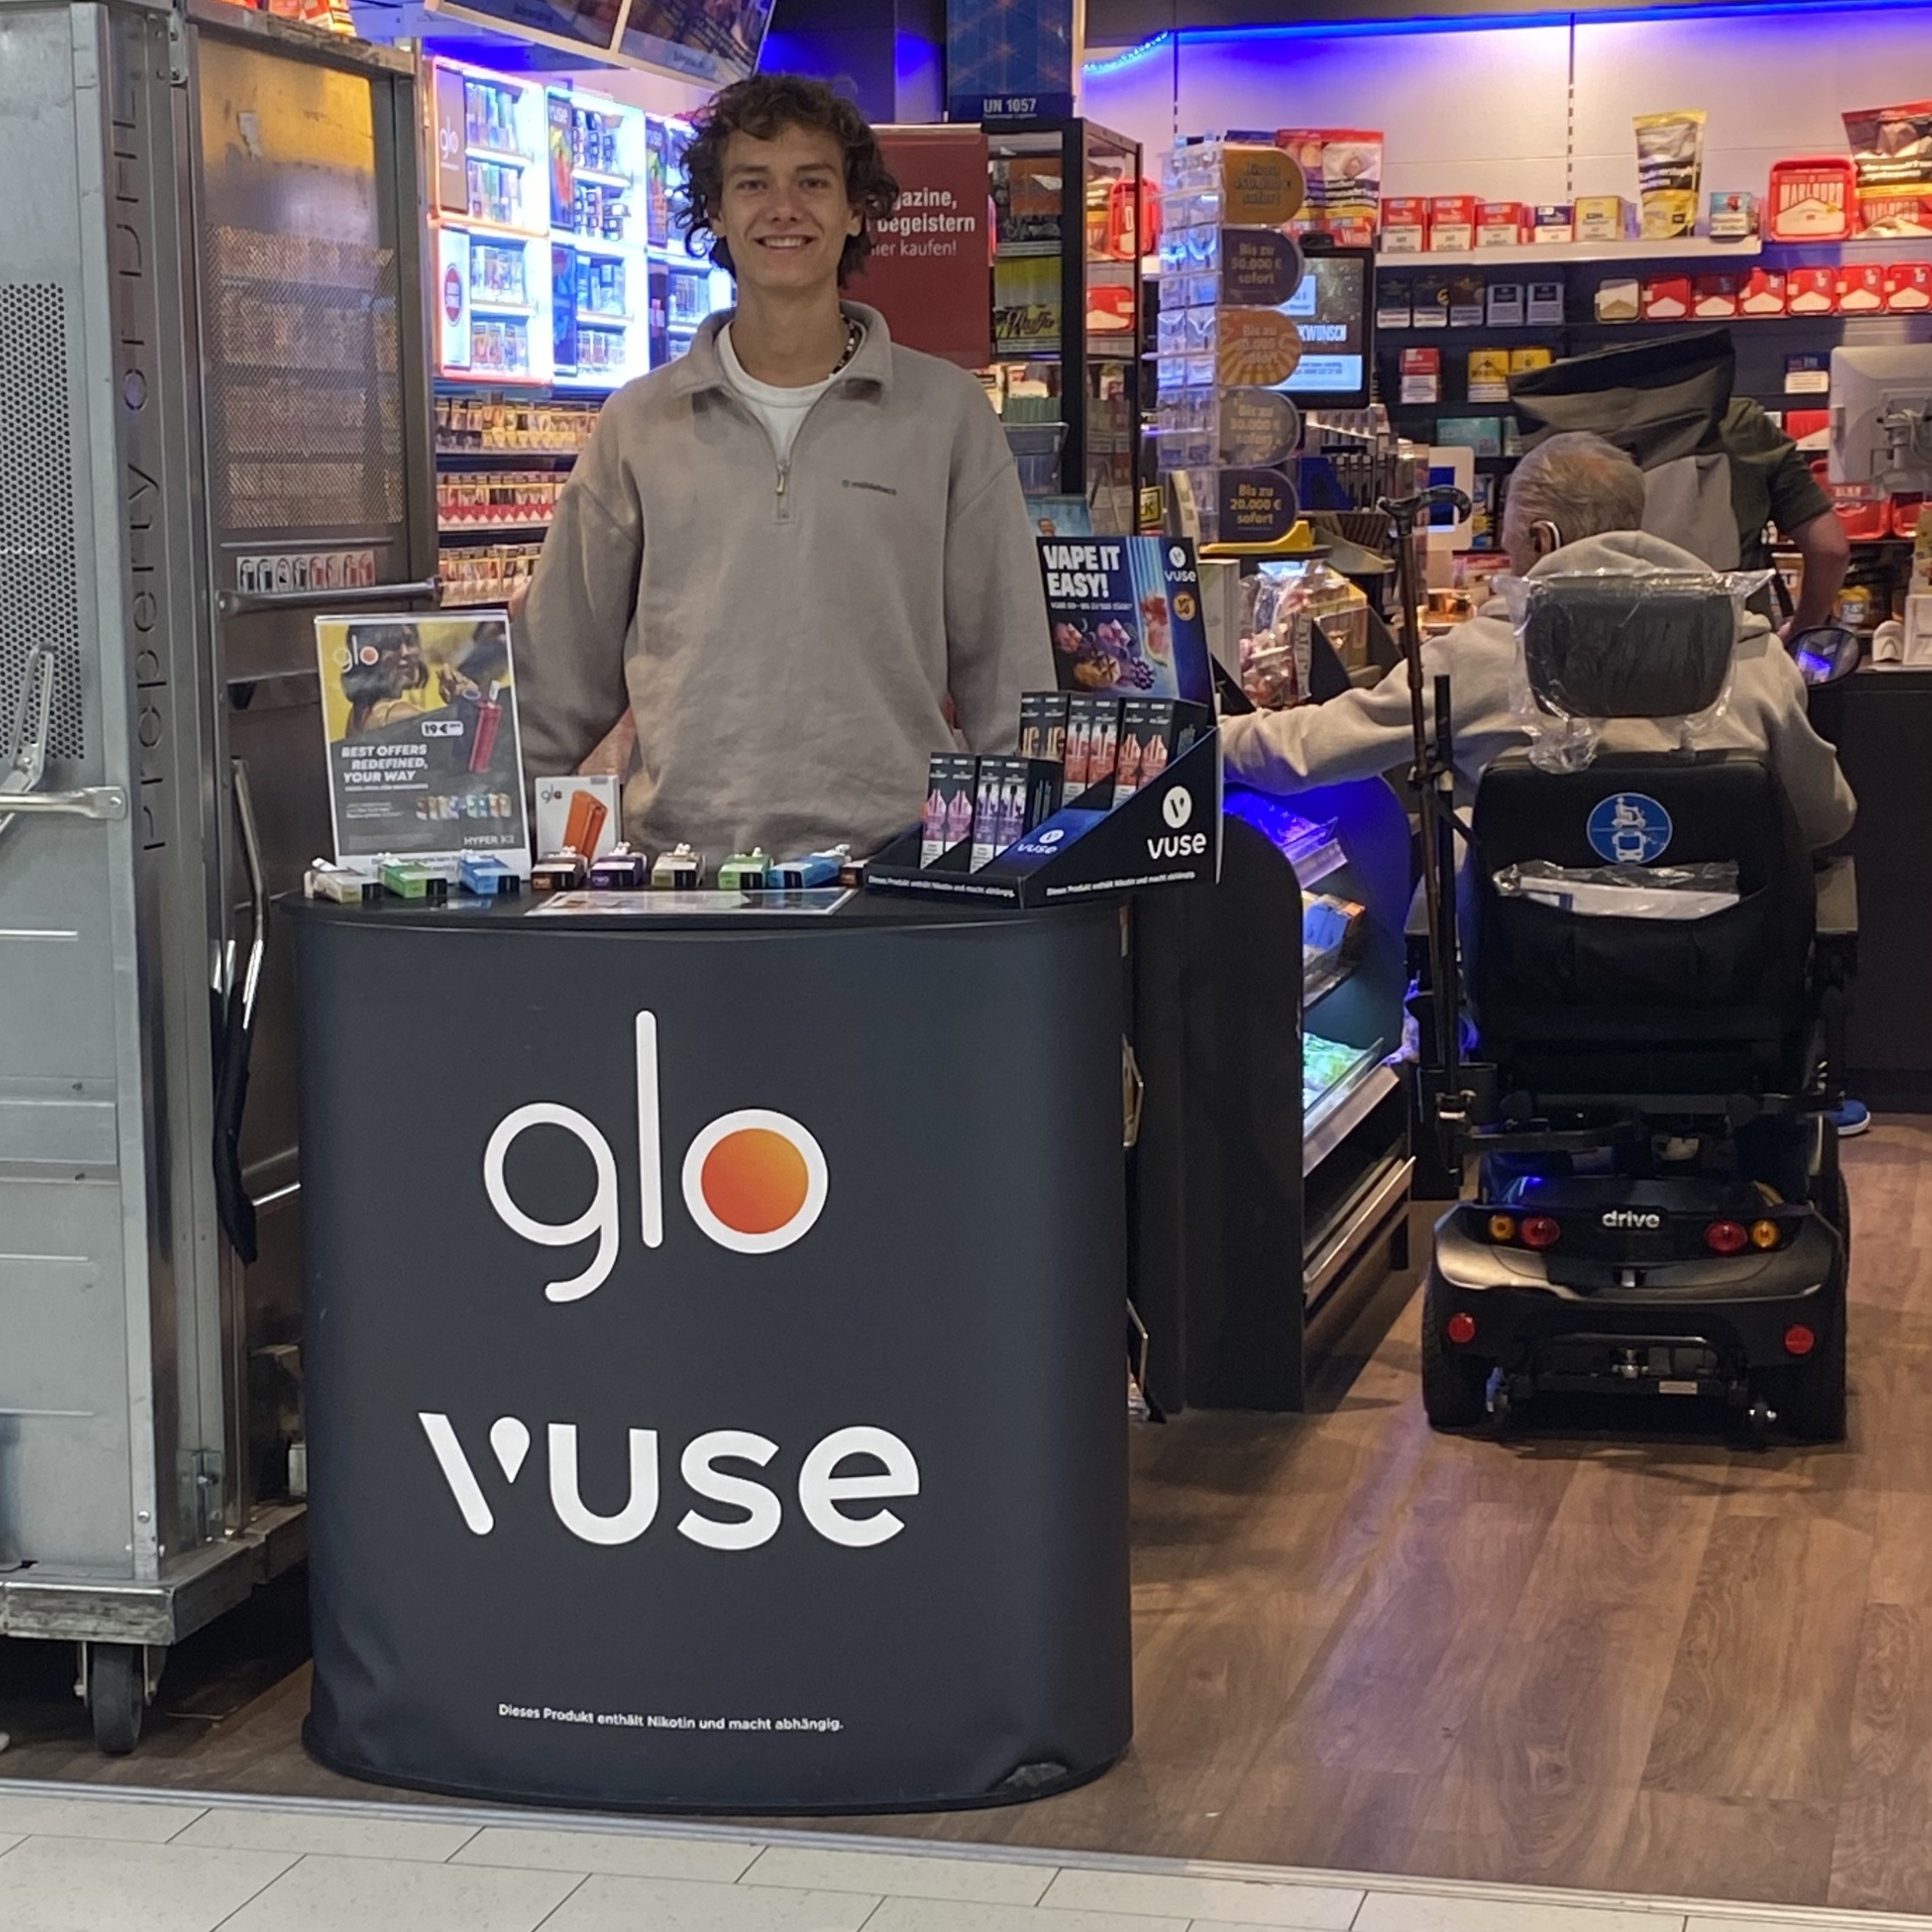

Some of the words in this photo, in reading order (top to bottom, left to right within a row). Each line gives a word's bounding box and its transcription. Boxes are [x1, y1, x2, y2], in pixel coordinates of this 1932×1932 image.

[983, 98, 1002, 113] UN
[1007, 98, 1037, 112] 1057
[902, 239, 957, 257] kaufen!
[1237, 271, 1275, 285] sofort
[1237, 484, 1256, 497] Bis
[1258, 487, 1274, 496] zu
[1230, 498, 1271, 511] 20.000
[1273, 499, 1282, 511] €
[1236, 513, 1273, 525] sofort
[1042, 545, 1098, 570] VAPE
[1100, 545, 1121, 570] IT
[1046, 573, 1109, 598] EASY!
[333, 634, 380, 674] glo
[342, 745, 375, 758] BEST
[376, 744, 428, 756] OFFERS
[351, 756, 428, 770] REDEFINED,
[343, 770, 381, 783] YOUR
[383, 769, 416, 782] WAY
[464, 835, 498, 846] HYPER
[1146, 832, 1207, 860] vuse
[1017, 843, 1058, 854] vuse
[483, 1010, 829, 1303] glo
[1602, 1210, 1661, 1229] drive
[417, 1411, 920, 1551] vuse
[498, 1703, 541, 1719] Dieses
[544, 1707, 594, 1724] Produkt
[597, 1712, 644, 1728] enthält
[647, 1715, 696, 1729] Nikotin
[699, 1716, 725, 1730] und
[729, 1718, 772, 1731] macht
[775, 1716, 844, 1733] abhängig.
